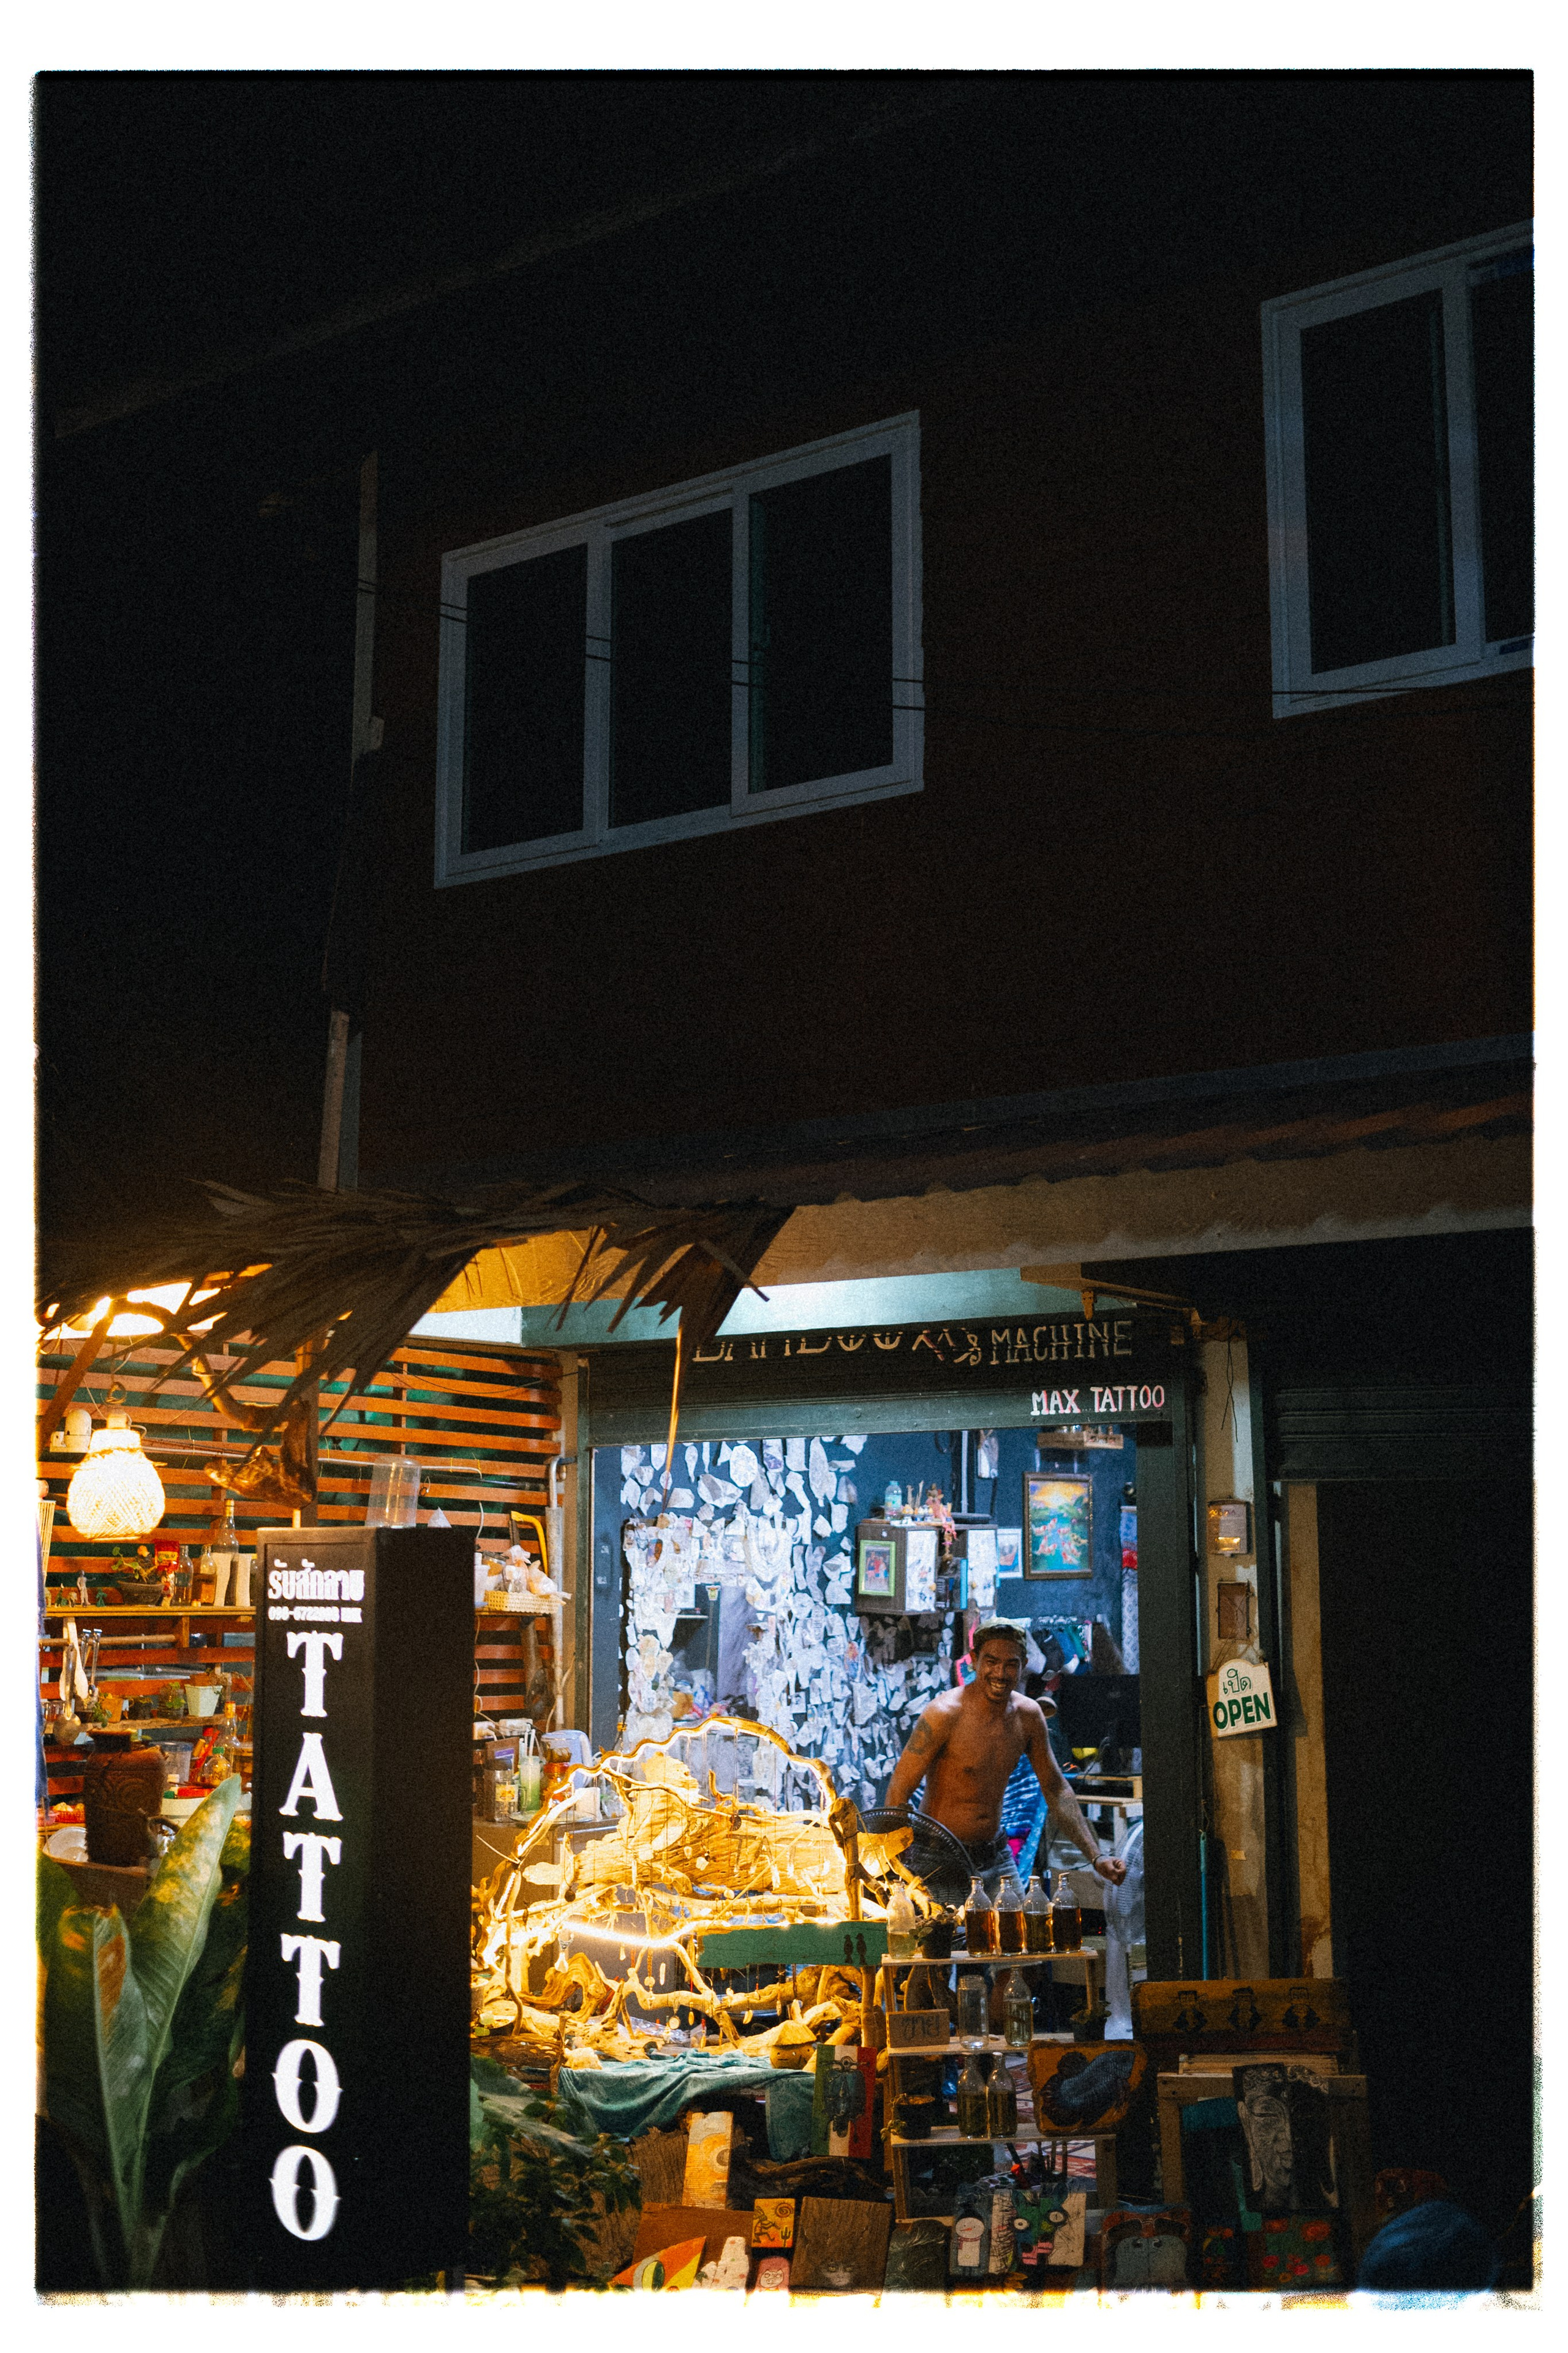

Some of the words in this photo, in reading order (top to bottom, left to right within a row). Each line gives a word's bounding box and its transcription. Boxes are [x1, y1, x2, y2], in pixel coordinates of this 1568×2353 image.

[989, 1320, 1134, 1365] MACHINE
[1030, 1389, 1081, 1416] MAX
[1090, 1384, 1165, 1413] TATTOO
[268, 1558, 365, 1601] รับสักลาย
[1223, 1668, 1251, 1695] เปิด
[1213, 1691, 1272, 1729] OPEN
[268, 1630, 344, 2241] TATTOO
